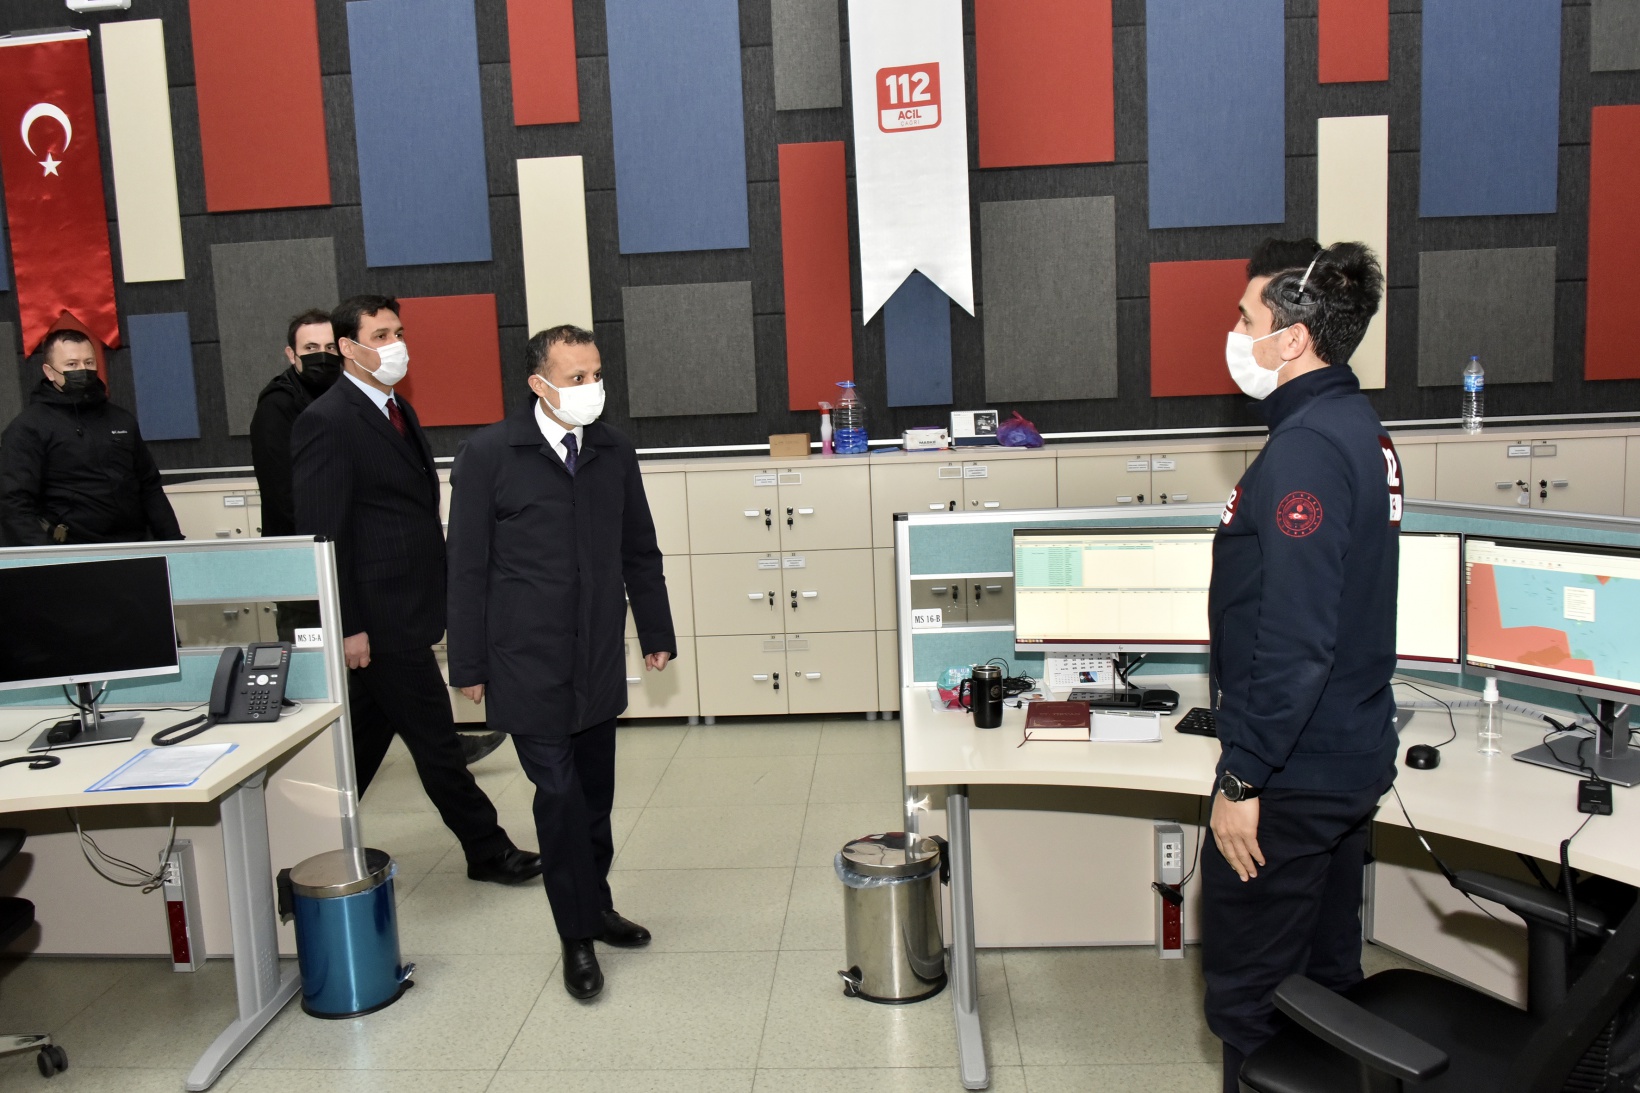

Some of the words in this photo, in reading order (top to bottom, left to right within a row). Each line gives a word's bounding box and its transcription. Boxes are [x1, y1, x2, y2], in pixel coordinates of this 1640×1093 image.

[886, 71, 931, 104] 112
[898, 109, 922, 120] ACİL
[914, 615, 925, 624] MS
[926, 615, 941, 623] 16-B
[297, 634, 307, 642] MS
[308, 634, 322, 642] 15-A
